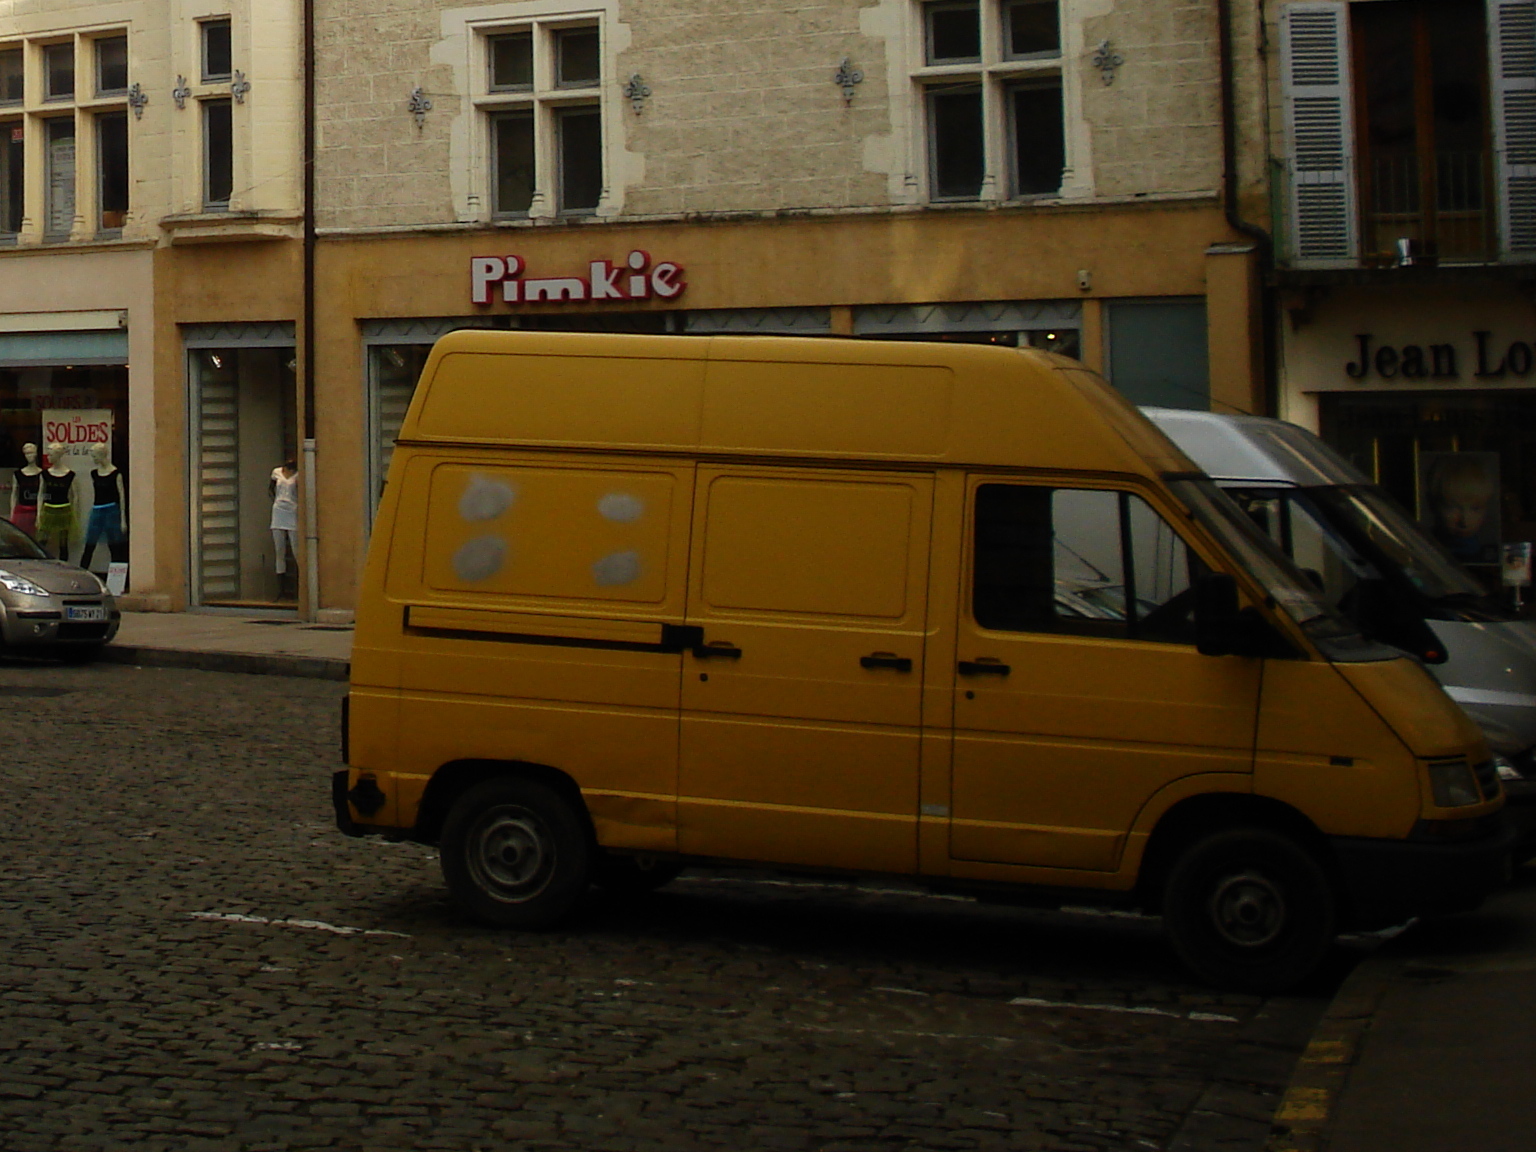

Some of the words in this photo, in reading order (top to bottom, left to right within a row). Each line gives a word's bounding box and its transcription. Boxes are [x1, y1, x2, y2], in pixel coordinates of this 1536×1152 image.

[470, 249, 688, 306] Pimkie
[1346, 333, 1460, 379] Jean
[1472, 330, 1536, 378] Lo
[46, 421, 109, 444] SOLDES
